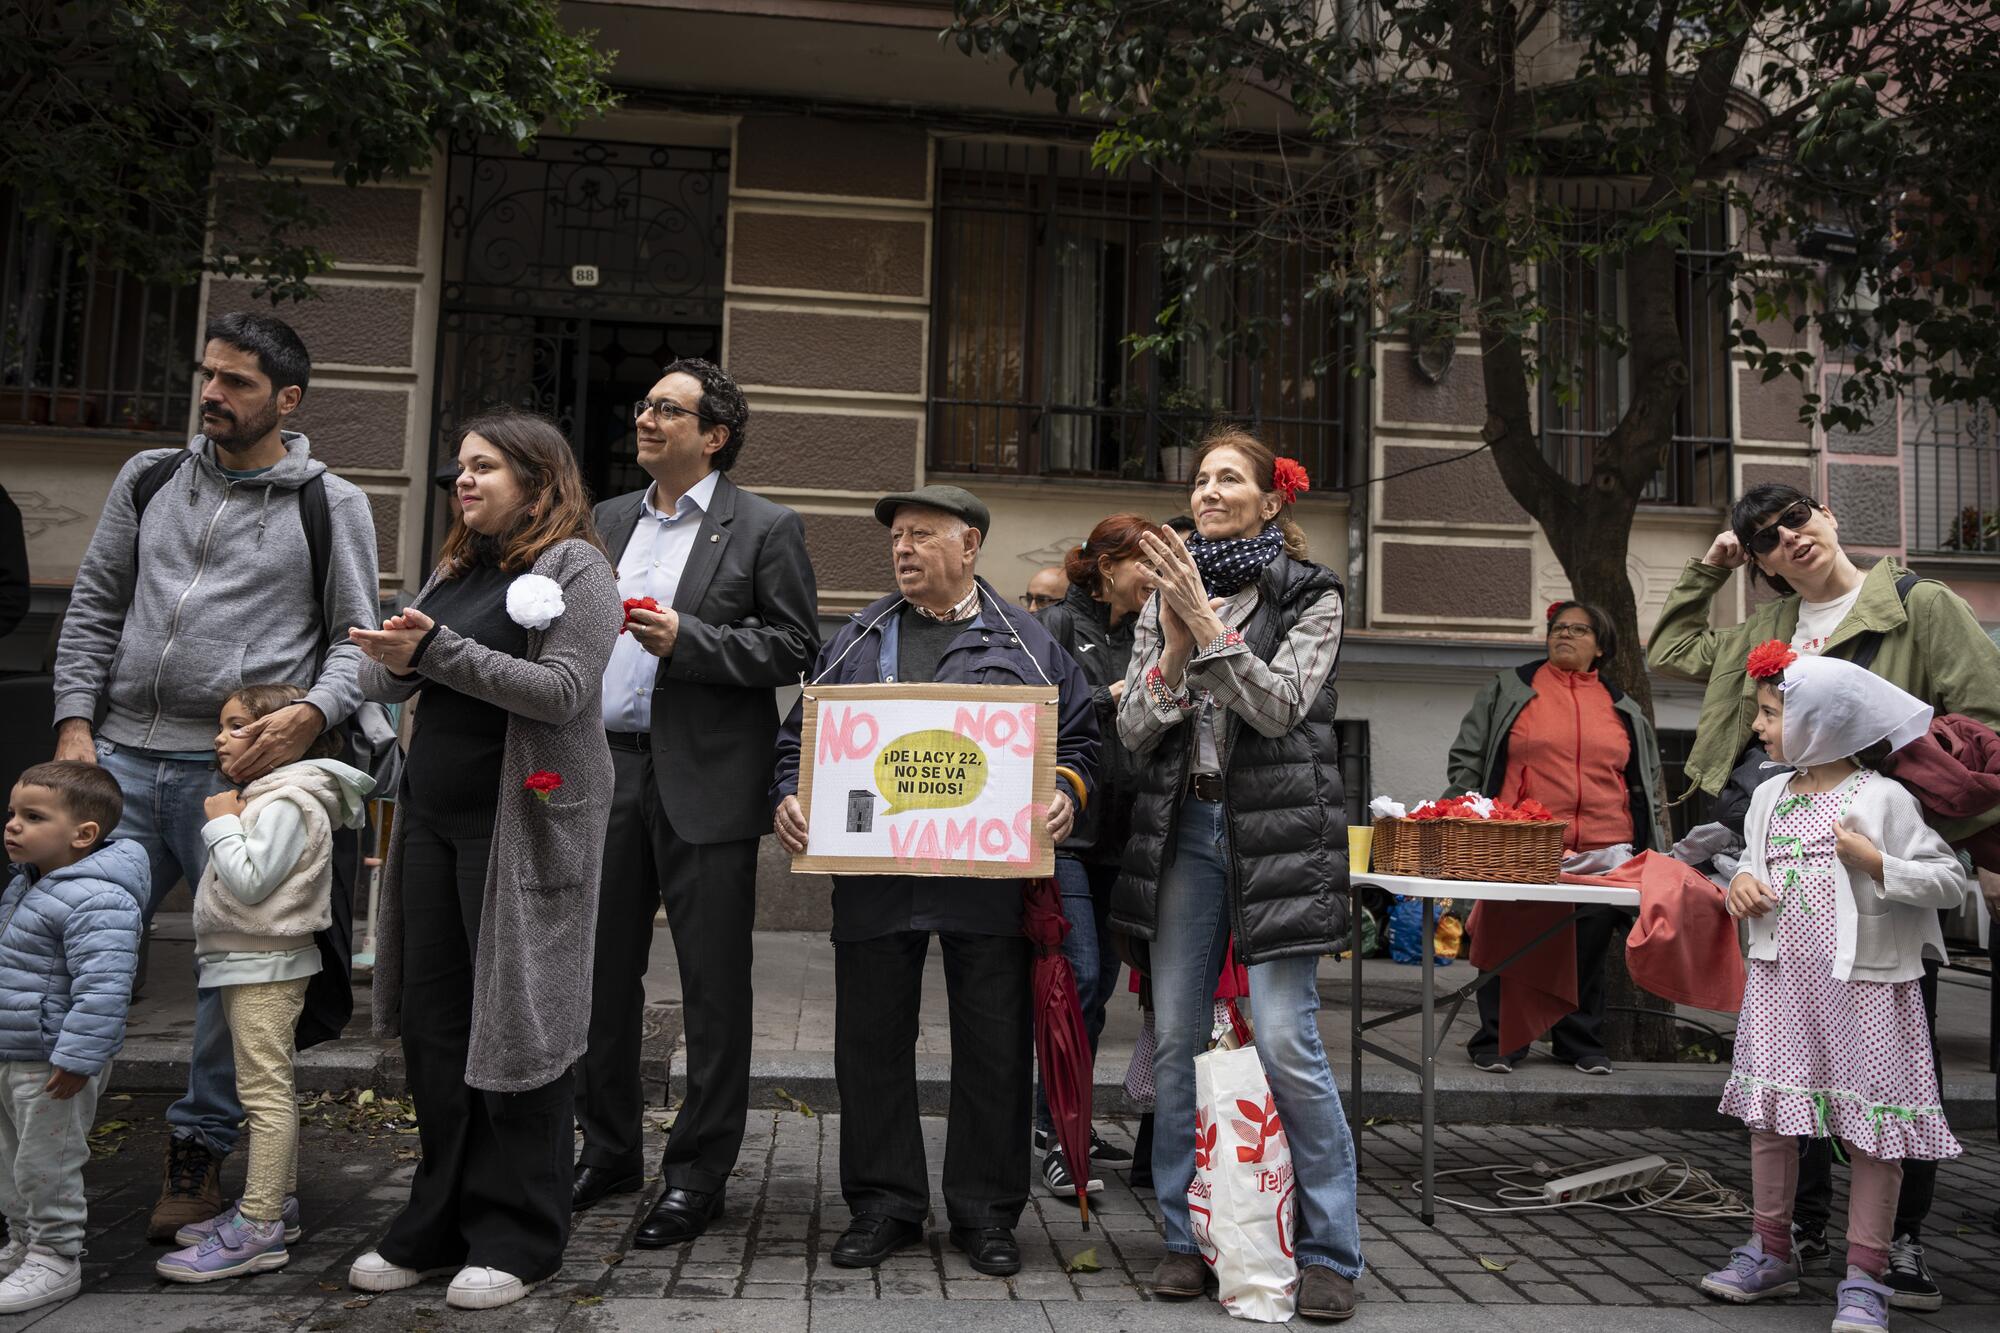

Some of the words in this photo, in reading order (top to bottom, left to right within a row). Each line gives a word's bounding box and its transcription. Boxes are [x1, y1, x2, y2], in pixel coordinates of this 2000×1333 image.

[576, 269, 594, 281] 88
[818, 705, 879, 765] NO
[953, 704, 1046, 758] NOS
[884, 750, 910, 765] ¡DE
[913, 750, 955, 763] LACY
[959, 752, 982, 766] 22,
[894, 765, 918, 778] NO
[920, 766, 941, 779] SE
[945, 767, 966, 780] VA
[898, 781, 914, 793] NI
[918, 781, 963, 795] DIOS!
[889, 804, 1047, 870] VAMOS
